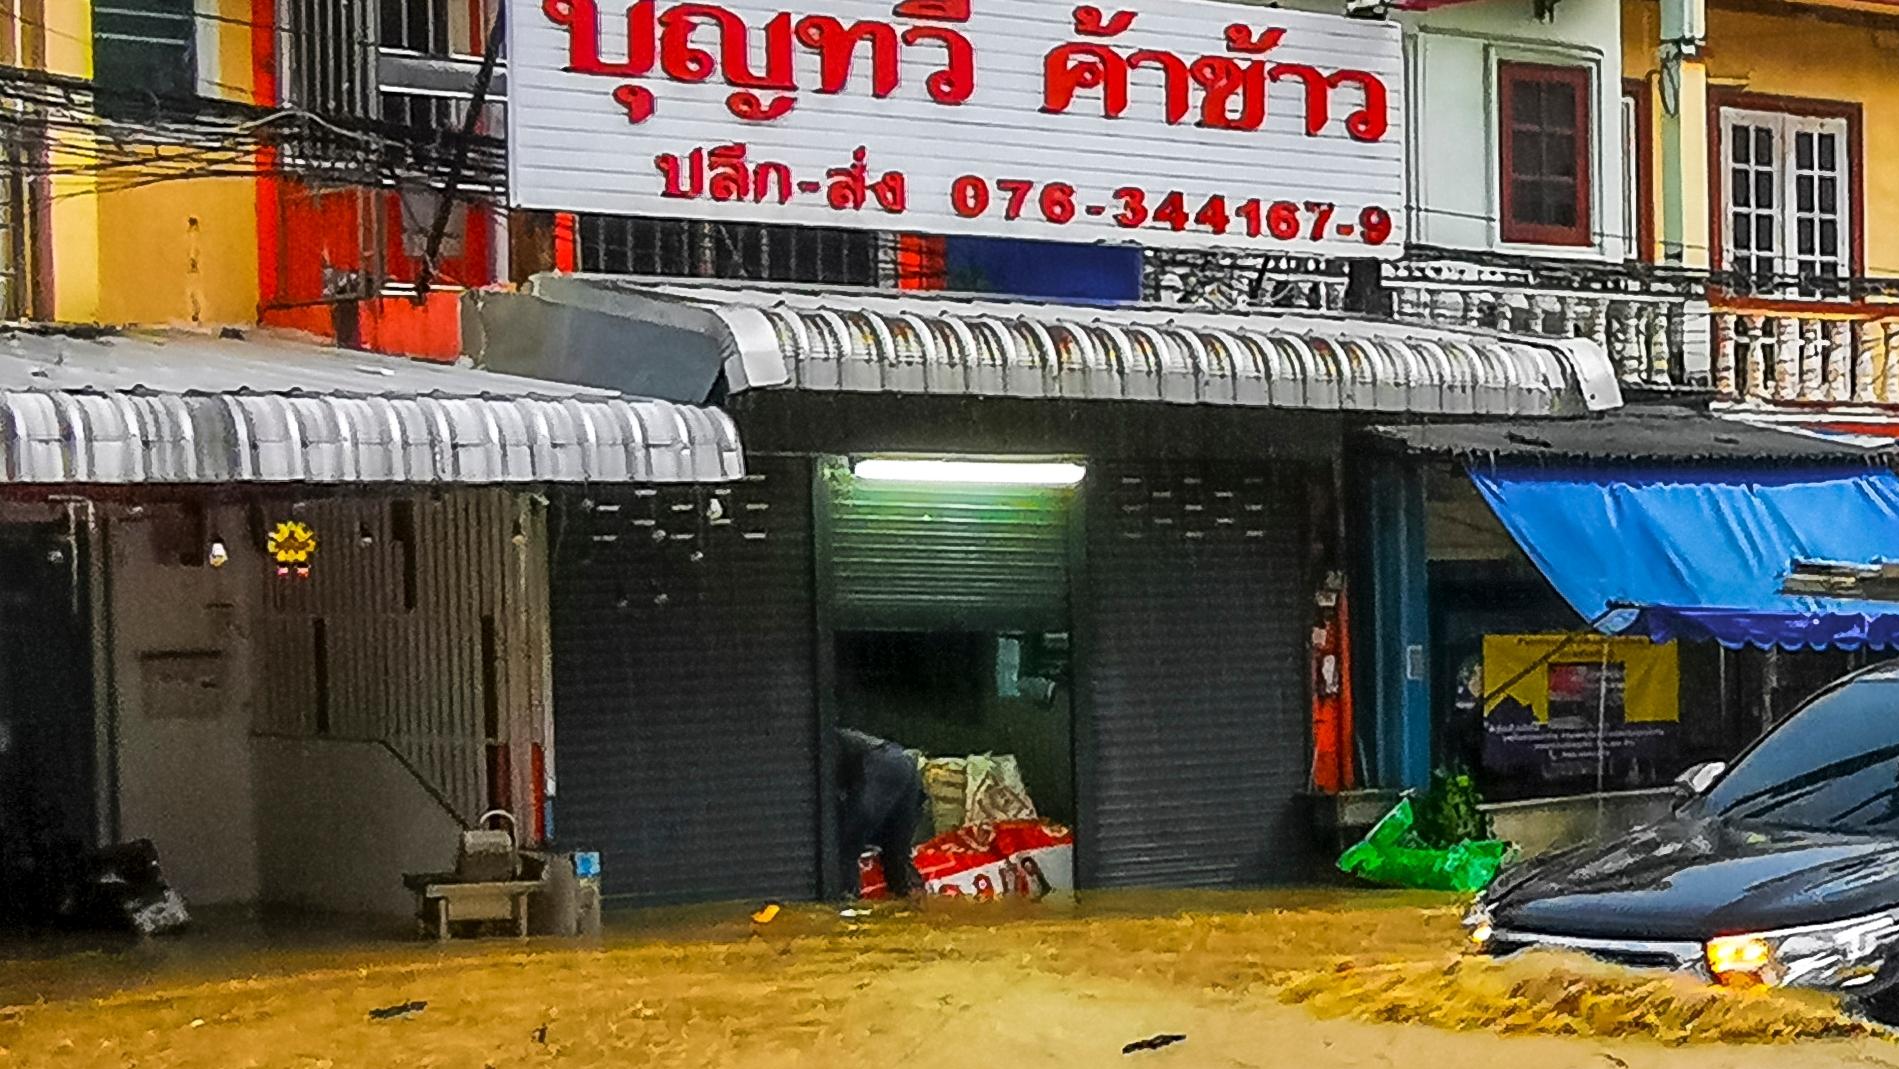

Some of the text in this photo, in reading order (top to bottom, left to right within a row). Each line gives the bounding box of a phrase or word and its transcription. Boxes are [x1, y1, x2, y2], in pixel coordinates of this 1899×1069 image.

[1038, 5, 1388, 142] ค้าข้าว
[655, 142, 1392, 245] ปลีก-ส่ง 076-344167-9
